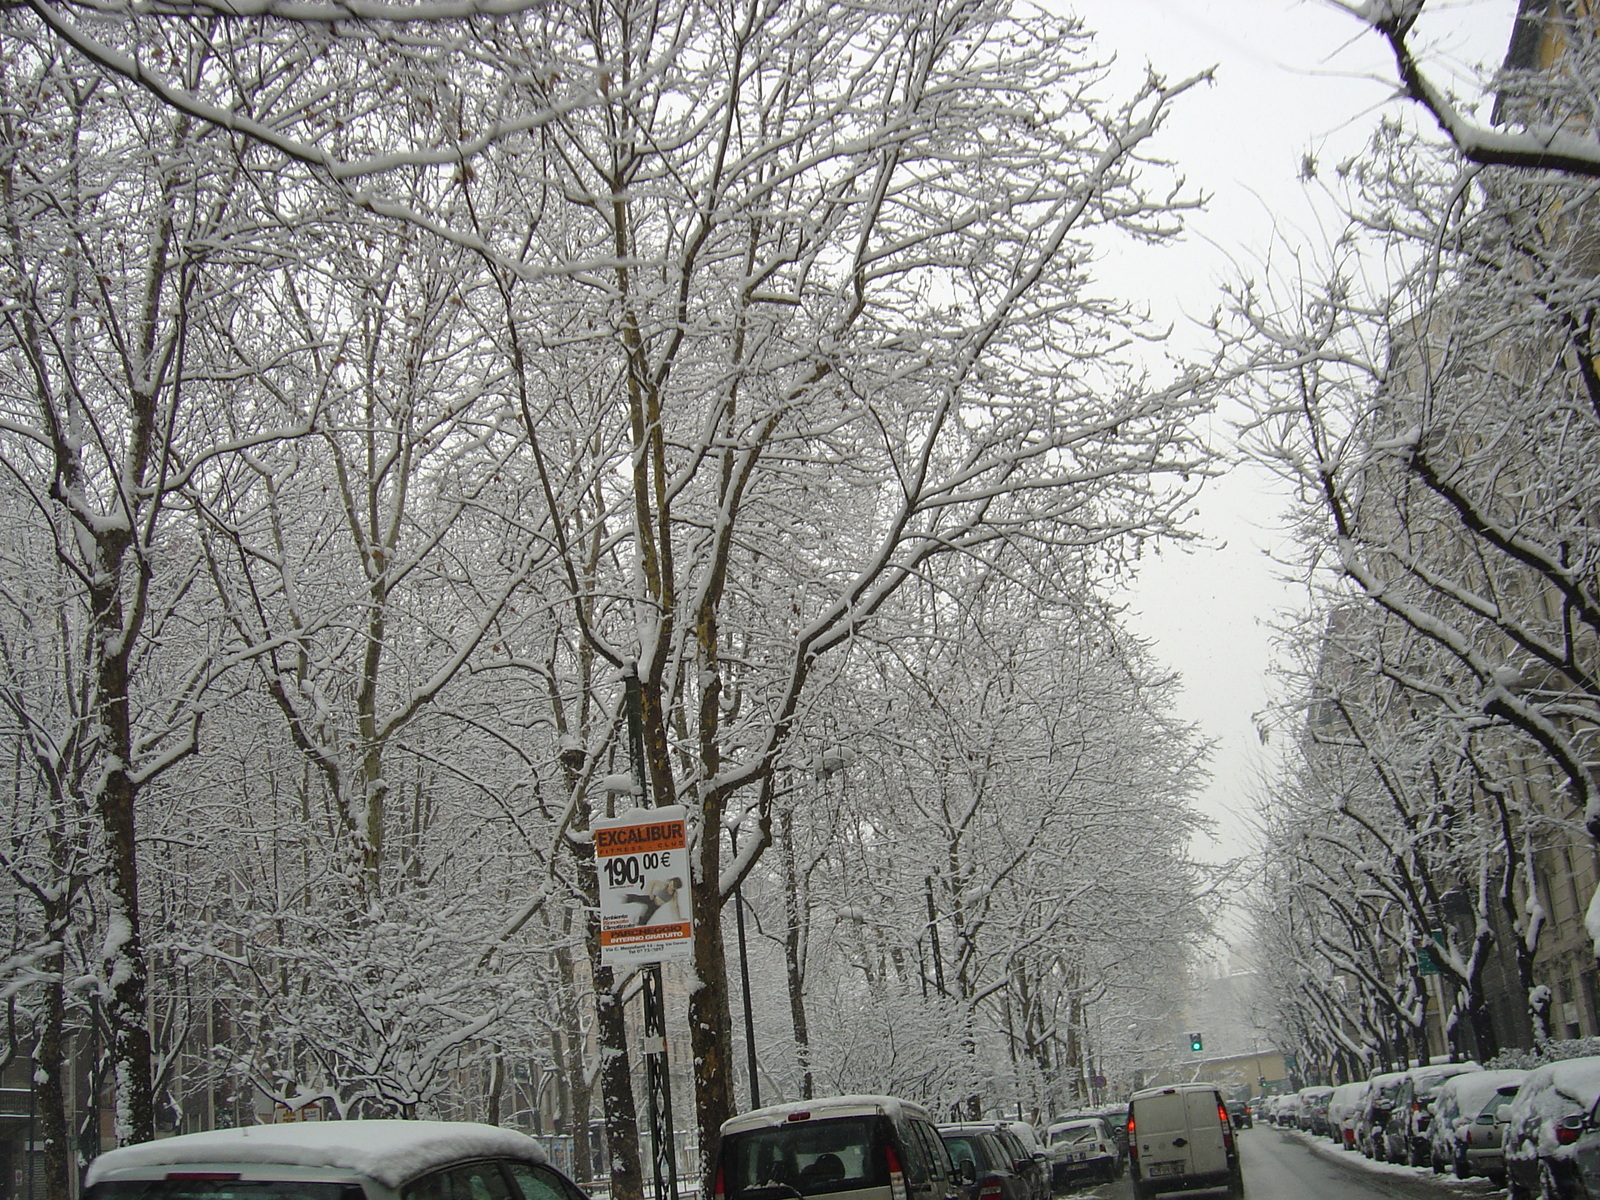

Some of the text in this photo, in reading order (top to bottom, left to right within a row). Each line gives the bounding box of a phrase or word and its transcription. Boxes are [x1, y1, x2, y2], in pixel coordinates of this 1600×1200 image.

[598, 823, 683, 846] EXCALIBUR
[600, 845, 643, 855] FITNESS
[658, 840, 684, 848] CLUB
[603, 923, 635, 931] Climatizzato
[611, 925, 682, 938] PARCHEGGIO
[610, 935, 644, 943] INTERNO
[645, 931, 683, 941] GRATUITO
